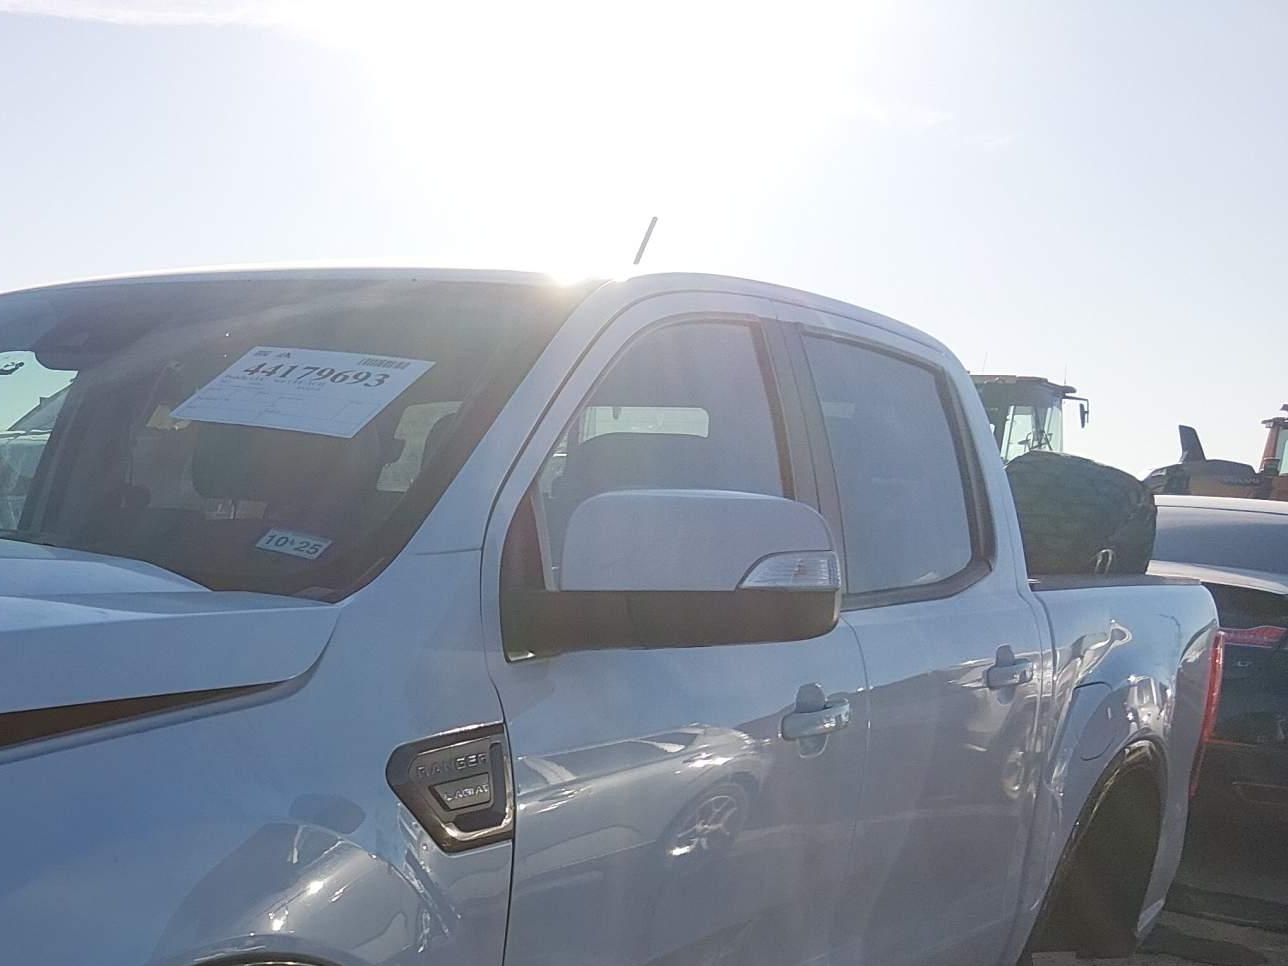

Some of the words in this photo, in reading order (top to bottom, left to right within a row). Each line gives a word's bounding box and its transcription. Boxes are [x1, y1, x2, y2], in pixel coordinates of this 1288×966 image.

[243, 362, 390, 387] 44179693
[265, 534, 289, 547] 10
[294, 540, 323, 555] 25
[416, 752, 487, 779] RANGER
